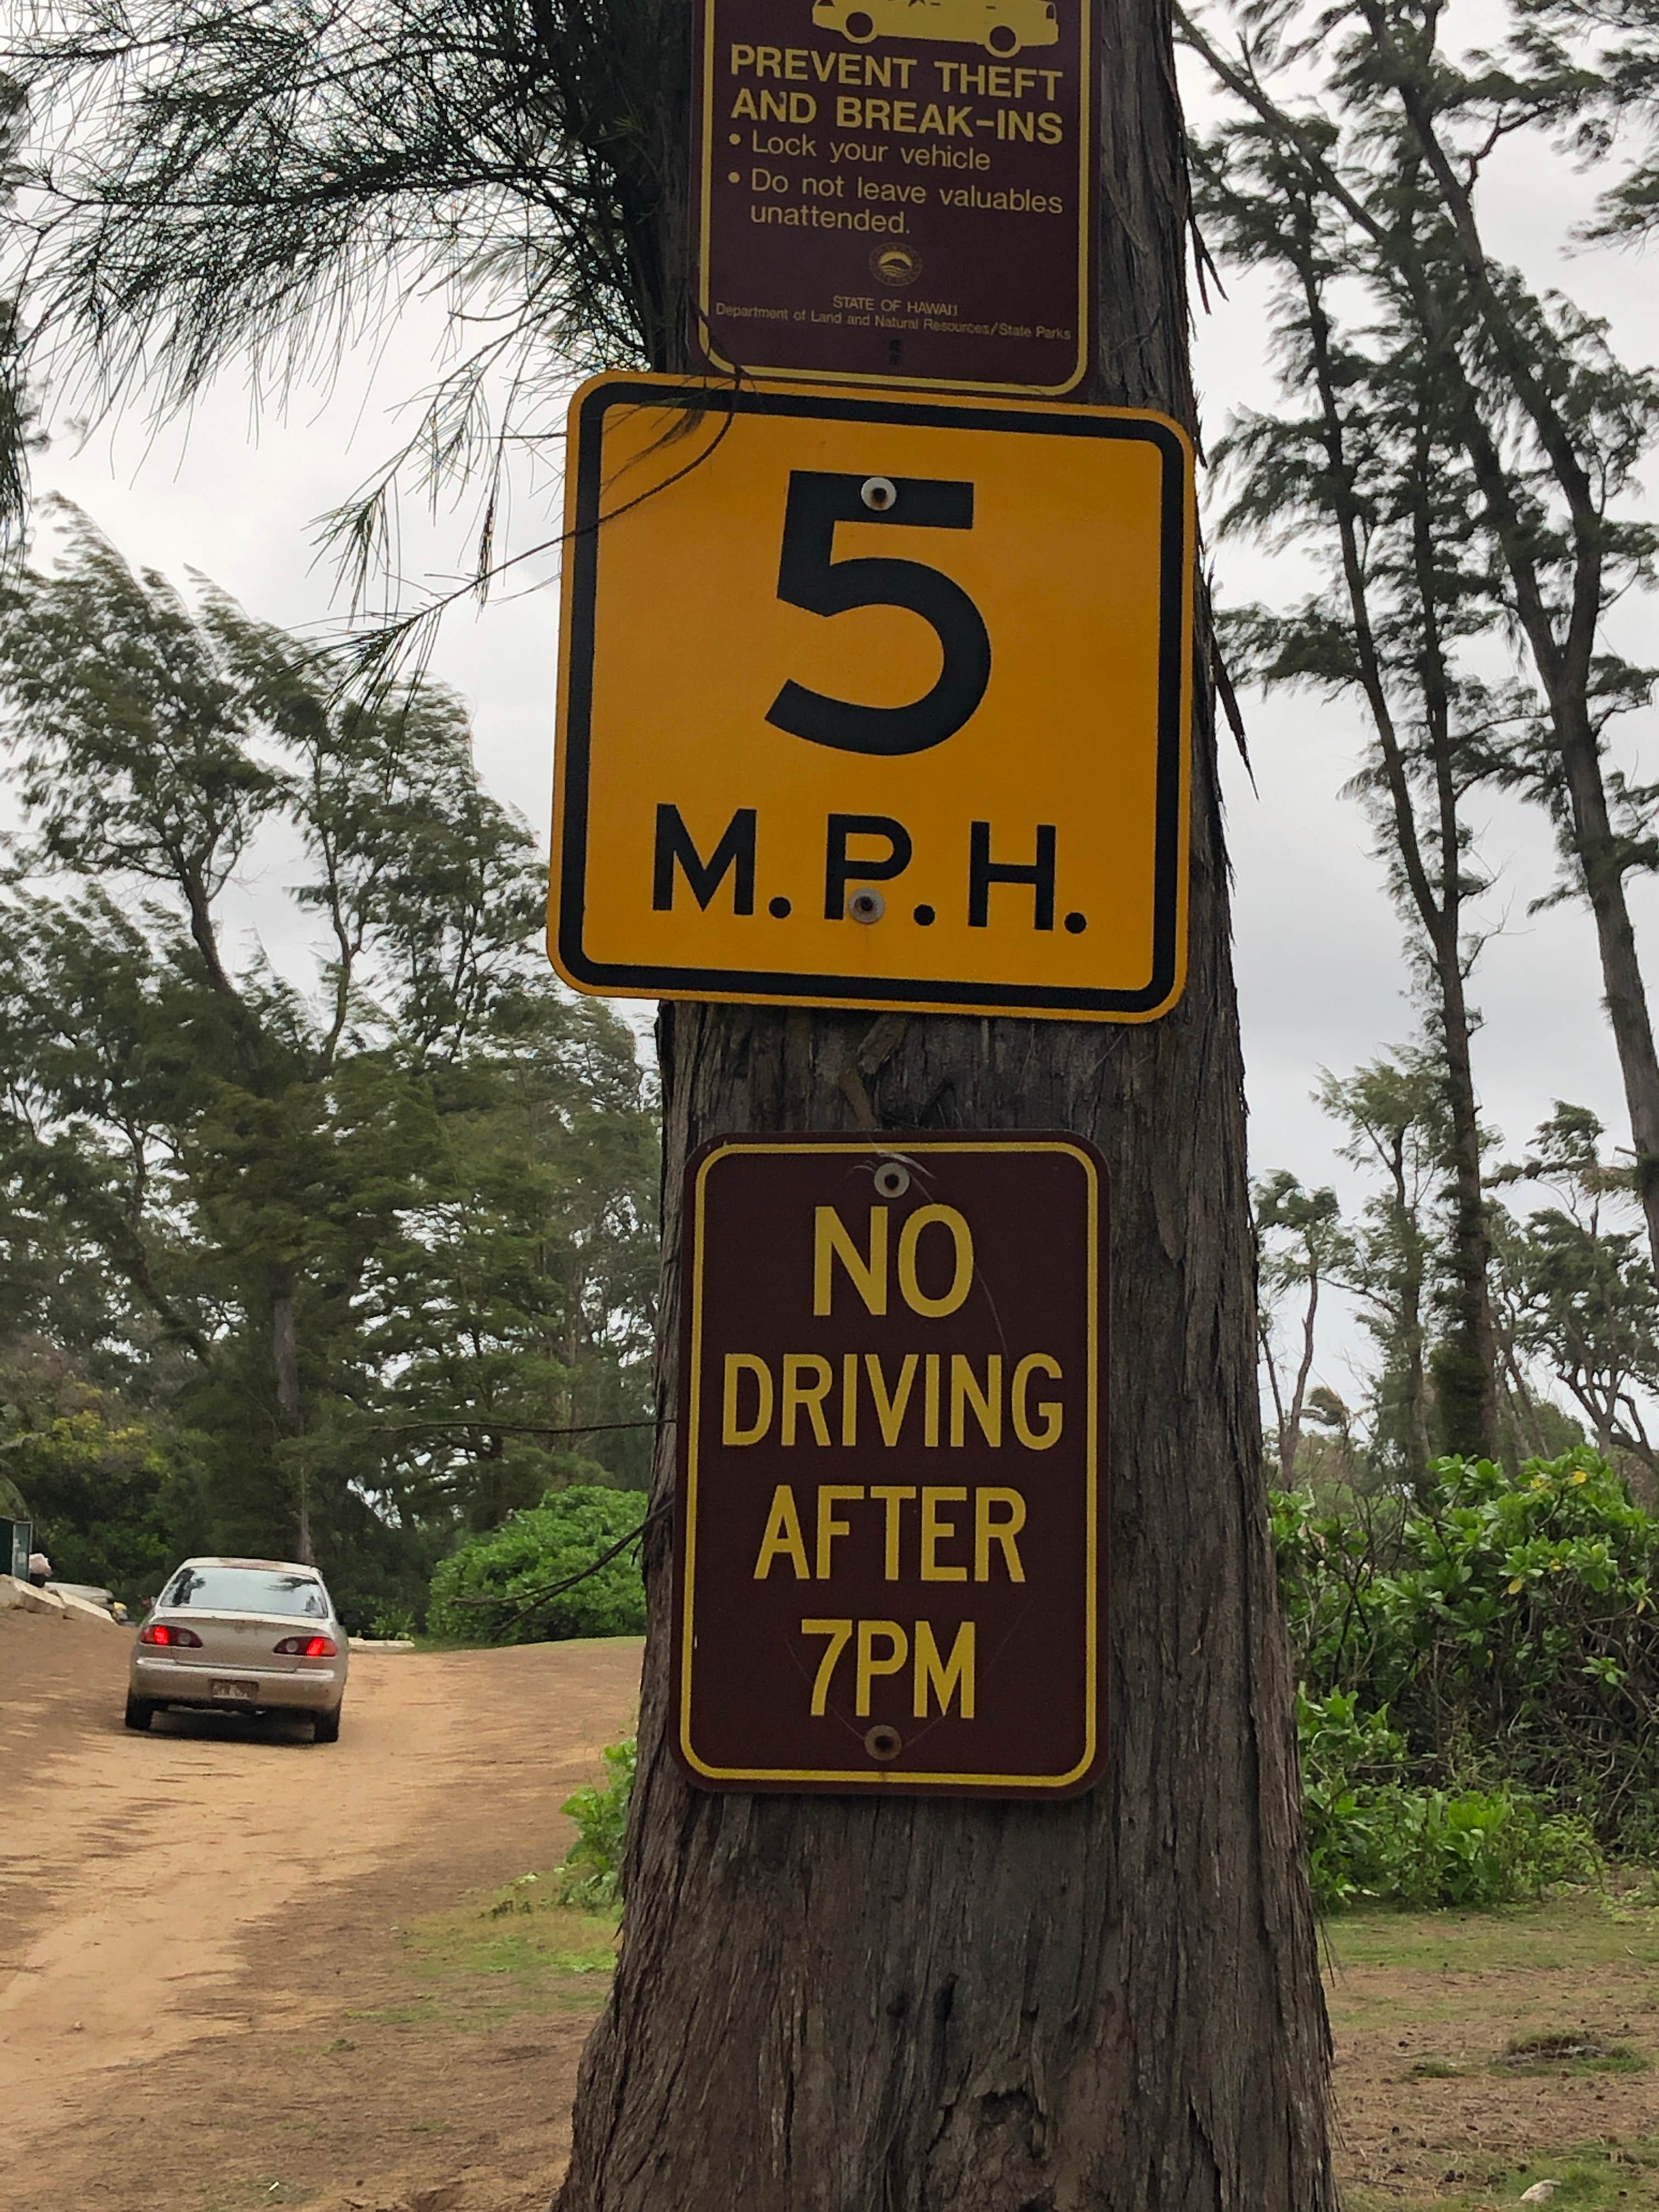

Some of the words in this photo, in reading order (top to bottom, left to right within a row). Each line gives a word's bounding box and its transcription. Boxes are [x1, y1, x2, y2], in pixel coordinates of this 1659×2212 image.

[731, 43, 917, 89] PREVENT
[934, 60, 1063, 101] THEFT
[731, 87, 817, 124] AND
[837, 95, 1063, 145] BREAK-INS
[752, 130, 817, 157] Lock
[830, 142, 888, 164] your
[901, 144, 991, 171] vehicle
[751, 204, 910, 234] unattended.
[752, 167, 789, 193] Do
[803, 177, 844, 198] not
[857, 179, 926, 205] leave
[940, 185, 1063, 215] valuables
[716, 302, 788, 320] Department
[793, 309, 806, 321] of
[811, 309, 842, 324] Land
[847, 314, 870, 326] and
[875, 314, 918, 330] Natural
[1036, 325, 1071, 340] Parks
[833, 295, 874, 311] STATE
[881, 299, 901, 312] OF
[764, 470, 992, 756] 5
[812, 1203, 974, 1318] NO
[721, 1352, 1064, 1451] DRIVING
[754, 1484, 1026, 1583] AFTER
[800, 1618, 975, 1719] 7PM
